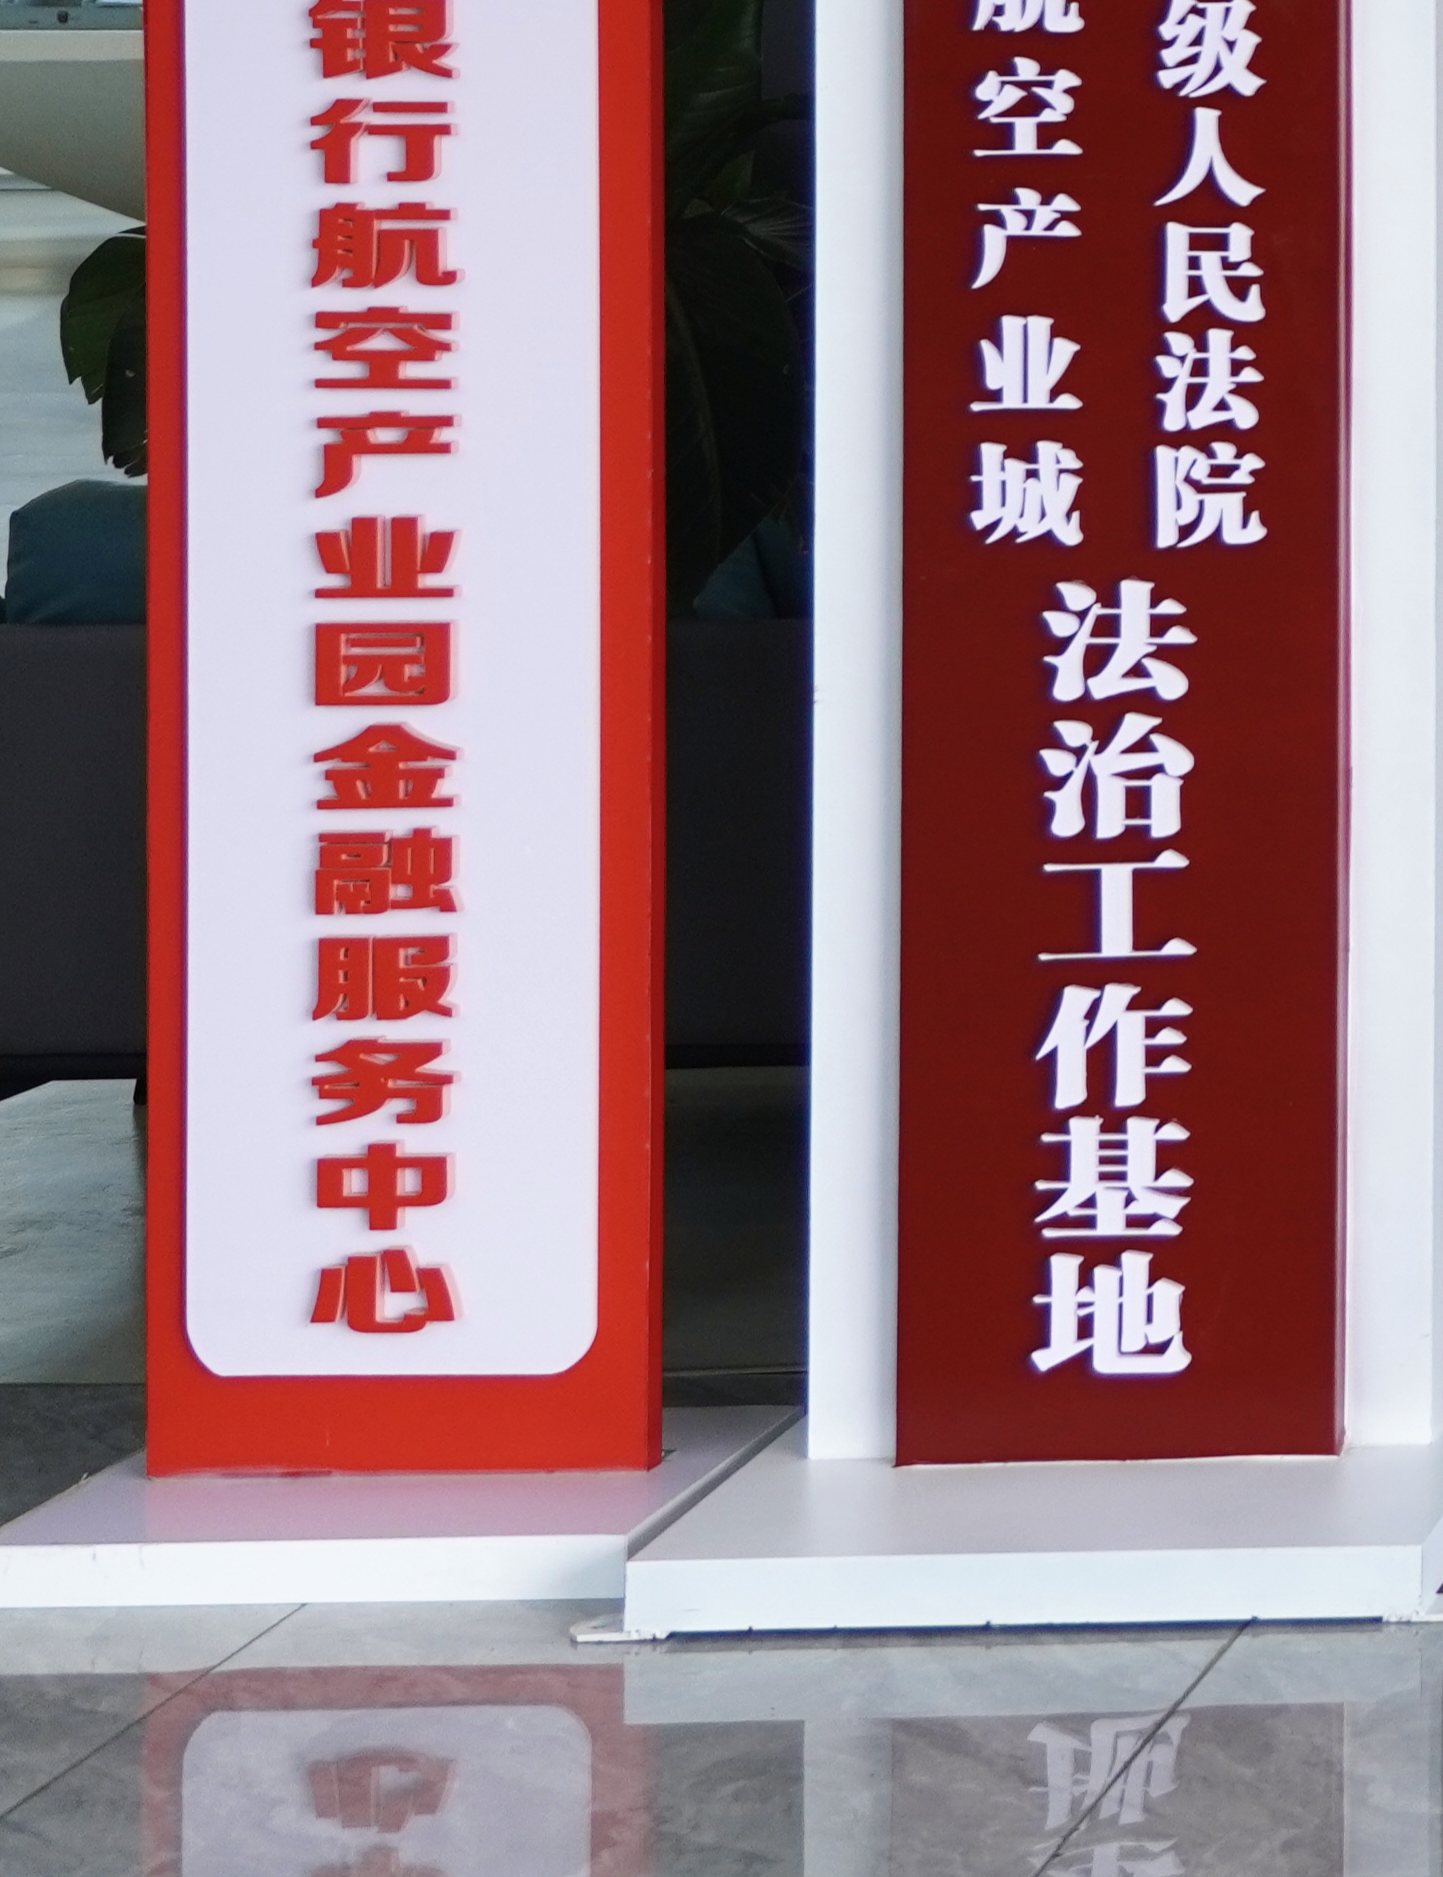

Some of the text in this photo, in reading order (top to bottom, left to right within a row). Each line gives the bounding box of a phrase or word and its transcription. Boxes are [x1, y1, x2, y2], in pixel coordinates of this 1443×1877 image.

[1031, 577, 1197, 1376] 法治工作基地
